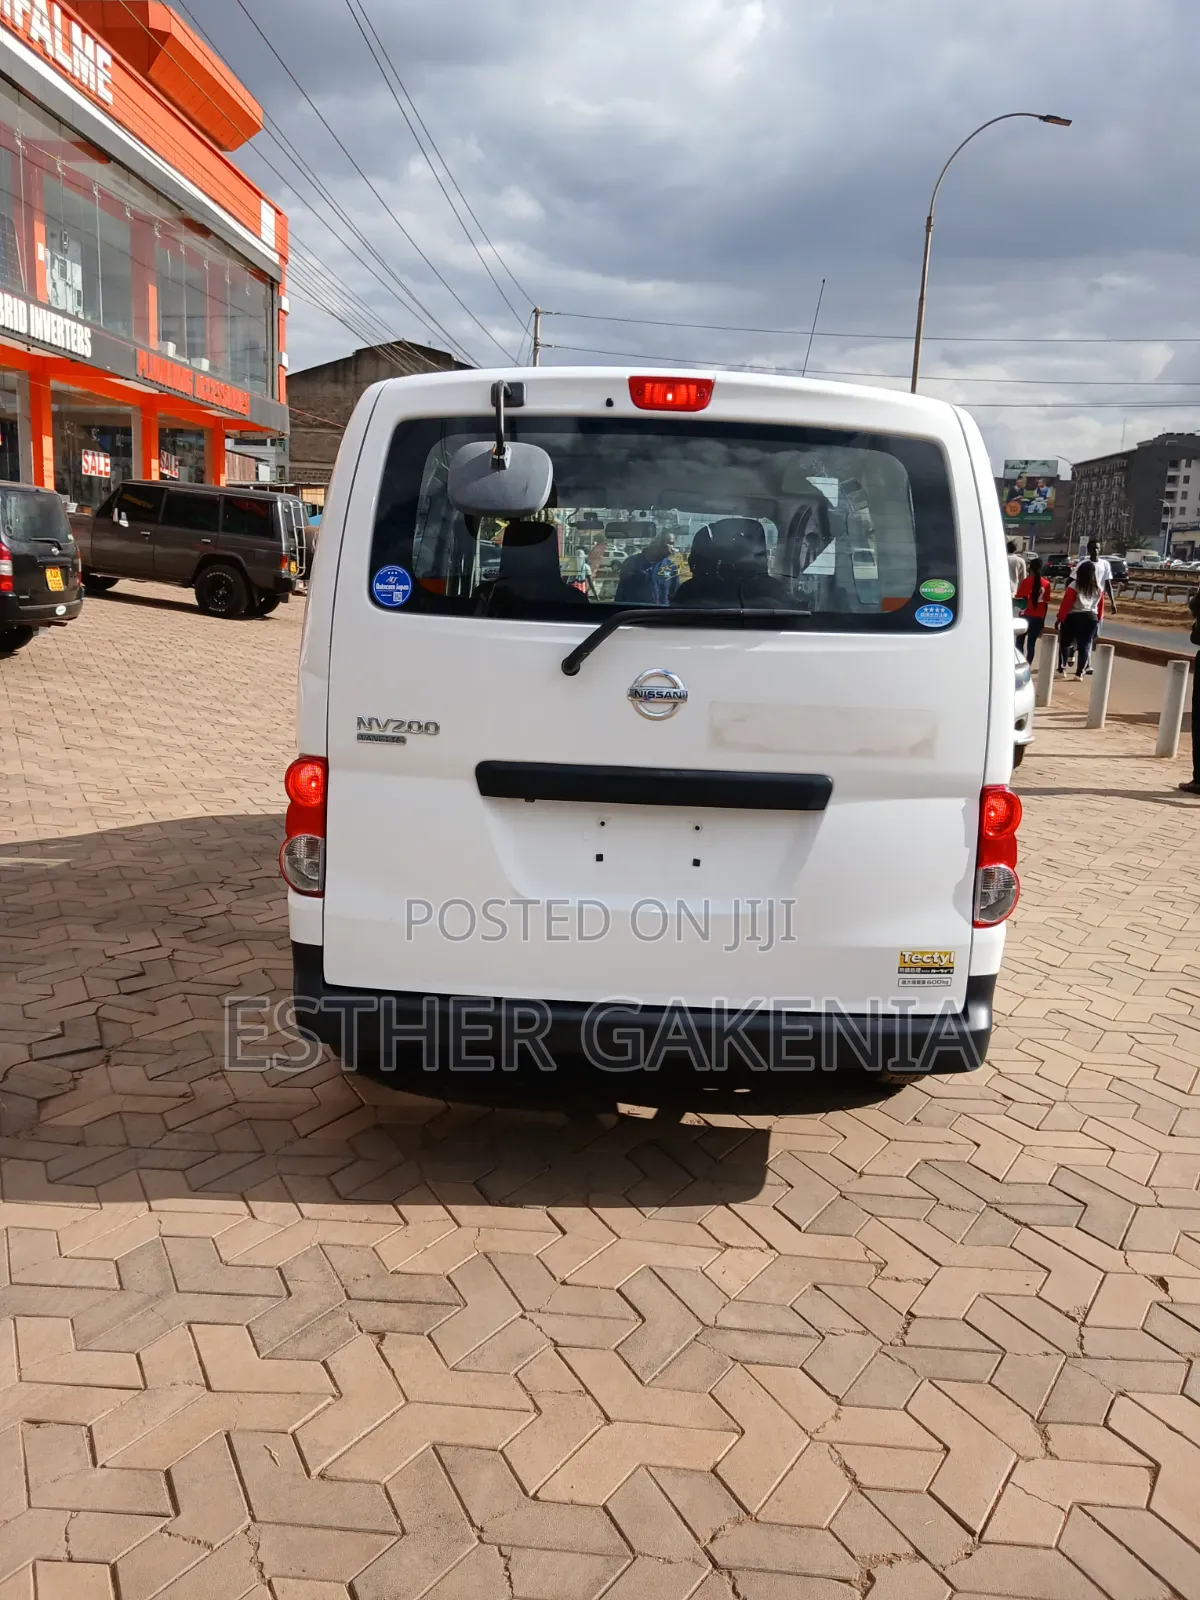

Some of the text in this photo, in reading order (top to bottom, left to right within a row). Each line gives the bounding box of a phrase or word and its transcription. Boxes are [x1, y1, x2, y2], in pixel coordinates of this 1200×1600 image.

[29, 303, 92, 358] INVERTERS
[82, 449, 110, 477] SALE
[160, 451, 179, 477] SALE
[634, 690, 682, 699] NISSAN
[356, 715, 441, 735] NV200
[901, 951, 955, 966] Tectyl
